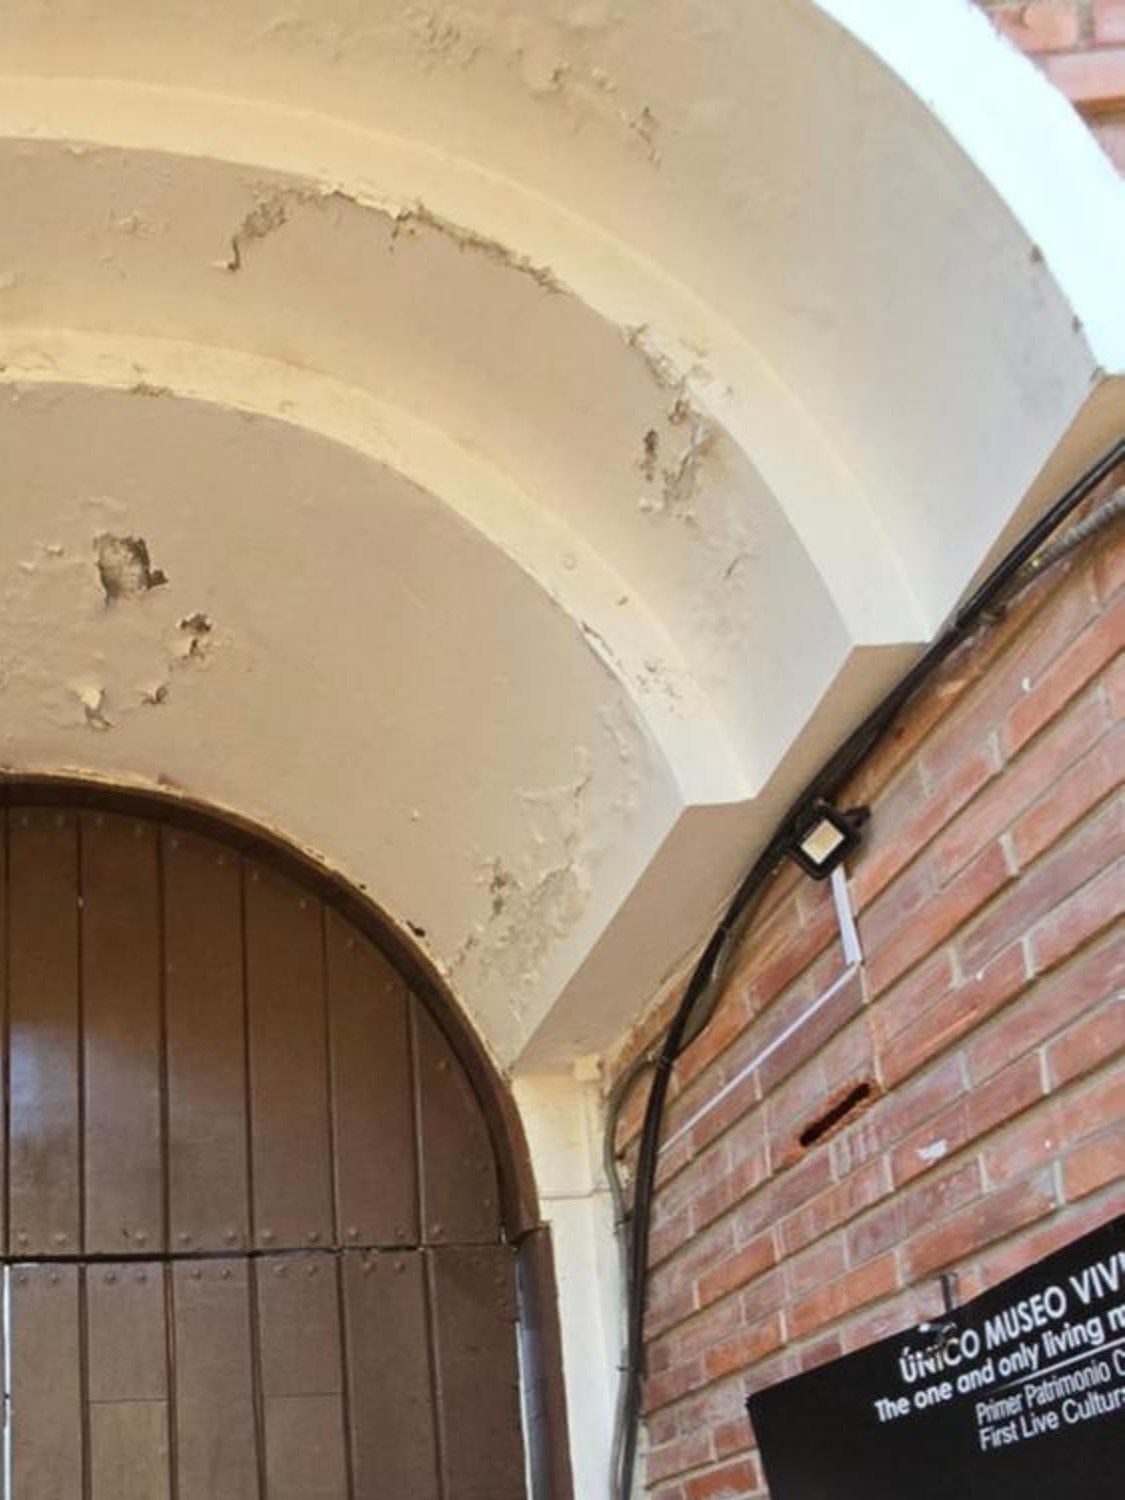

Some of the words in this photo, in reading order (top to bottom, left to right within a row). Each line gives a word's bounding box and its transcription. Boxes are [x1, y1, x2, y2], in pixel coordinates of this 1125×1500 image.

[985, 1285, 1067, 1350] MUSEO
[874, 1396, 910, 1422] The
[914, 1381, 953, 1409] one
[957, 1358, 995, 1393] and
[999, 1341, 1039, 1377] only
[1041, 1316, 1105, 1358] living
[976, 1393, 1023, 1425] Primer
[1024, 1360, 1111, 1409] Patrimonio
[979, 1421, 1020, 1451] First
[1020, 1411, 1060, 1438] Live
[1062, 1387, 1125, 1424] Cultur
